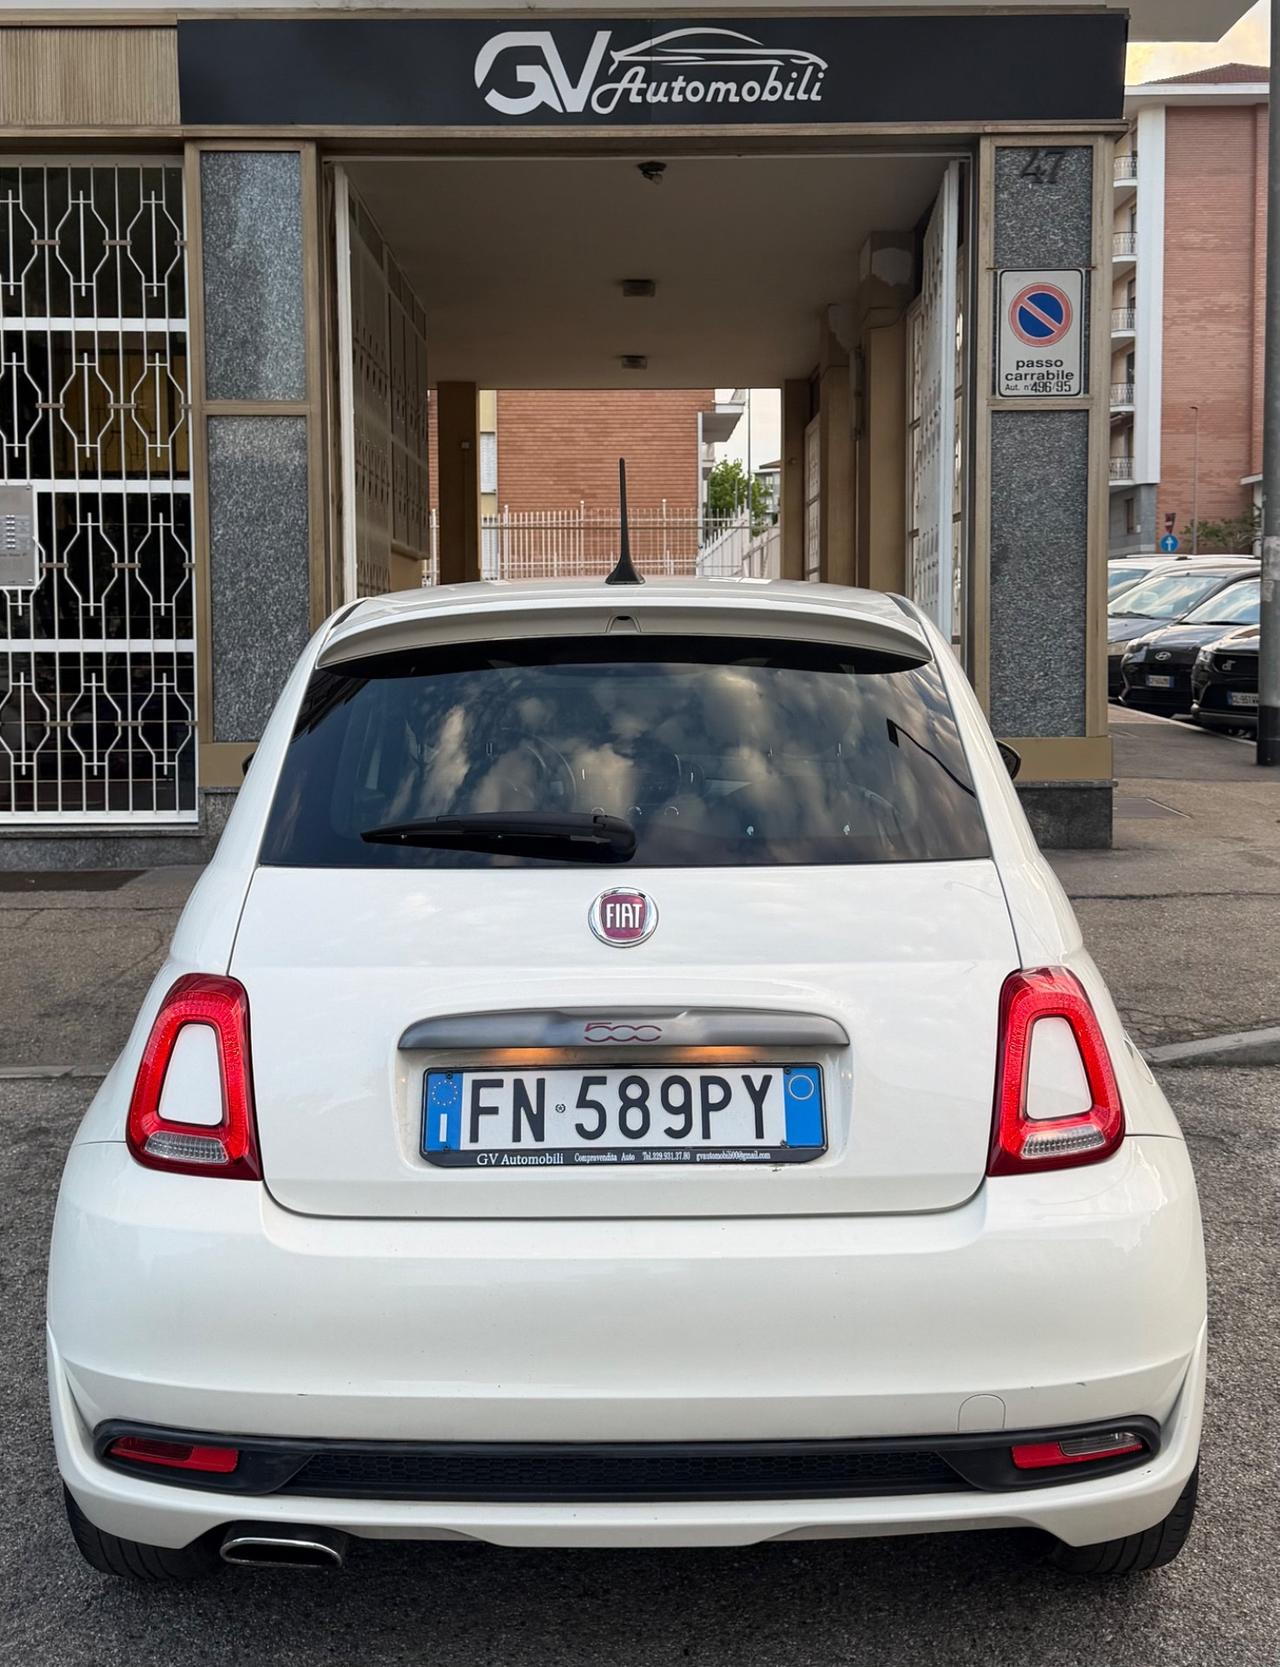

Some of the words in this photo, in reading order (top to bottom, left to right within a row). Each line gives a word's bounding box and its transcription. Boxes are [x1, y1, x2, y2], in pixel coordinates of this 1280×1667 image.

[474, 30, 612, 115] GV
[591, 63, 825, 115] Automobili
[1020, 148, 1066, 184] 47
[1005, 370, 1074, 381] carrabile
[1016, 359, 1064, 370] passo
[606, 903, 643, 928] FIAT
[584, 1022, 663, 1043] 500
[469, 1077, 546, 1143] FN
[574, 1074, 773, 1141] 589PY
[476, 1153, 498, 1166] GV
[501, 1153, 564, 1165] Automobili
[574, 1152, 617, 1164] Compravendita
[621, 1151, 635, 1162] Auto
